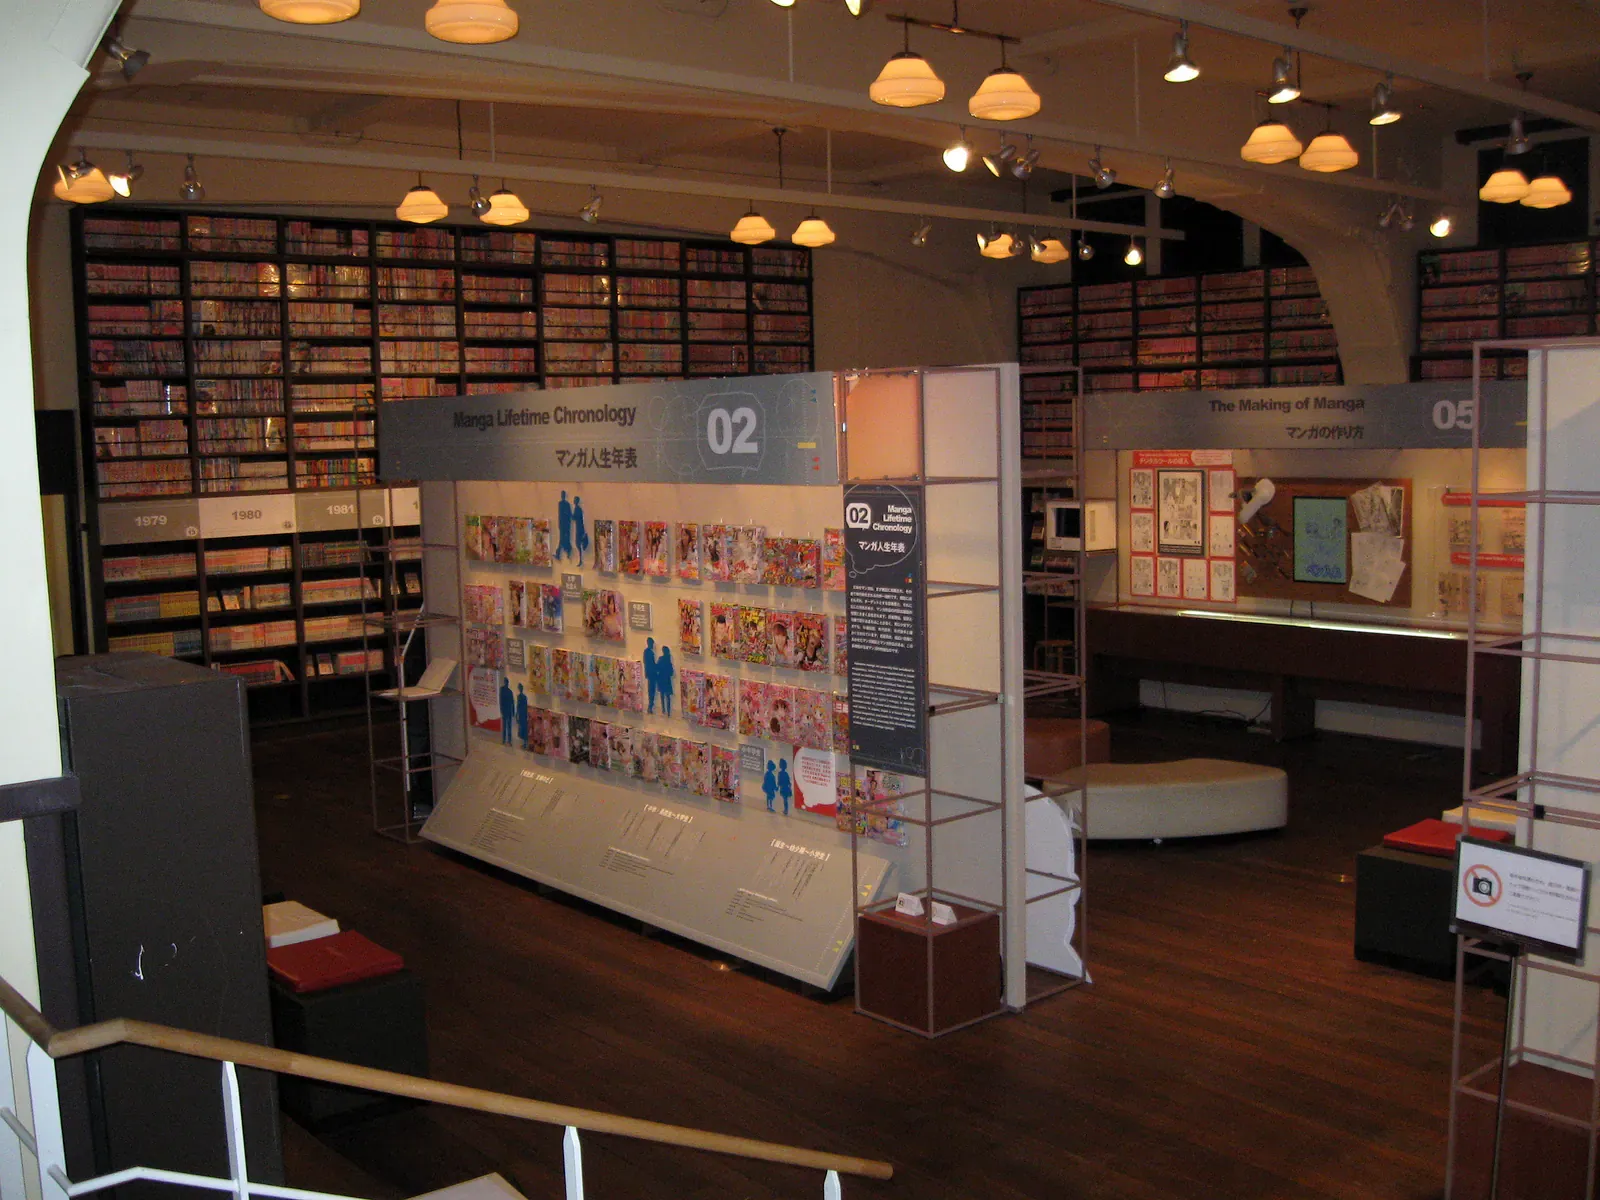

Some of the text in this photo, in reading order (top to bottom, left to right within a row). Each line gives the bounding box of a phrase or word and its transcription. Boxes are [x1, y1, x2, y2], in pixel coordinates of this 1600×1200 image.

[1209, 396, 1365, 414] The Making of Manga
[454, 403, 637, 431] Manga Lifetime Chronology
[1432, 399, 1476, 430] 05
[706, 407, 759, 456] 02
[1285, 425, 1365, 440] マンガの作り方
[555, 447, 638, 469] マンガ人生年表
[231, 509, 263, 521] 1980
[326, 504, 355, 515] 1981
[849, 507, 869, 524] 02
[887, 504, 912, 515] Manga
[134, 515, 168, 527] 1979
[882, 514, 912, 523] Lifetime
[872, 523, 912, 534] Chronology
[858, 541, 906, 553] マンガ人生年表
